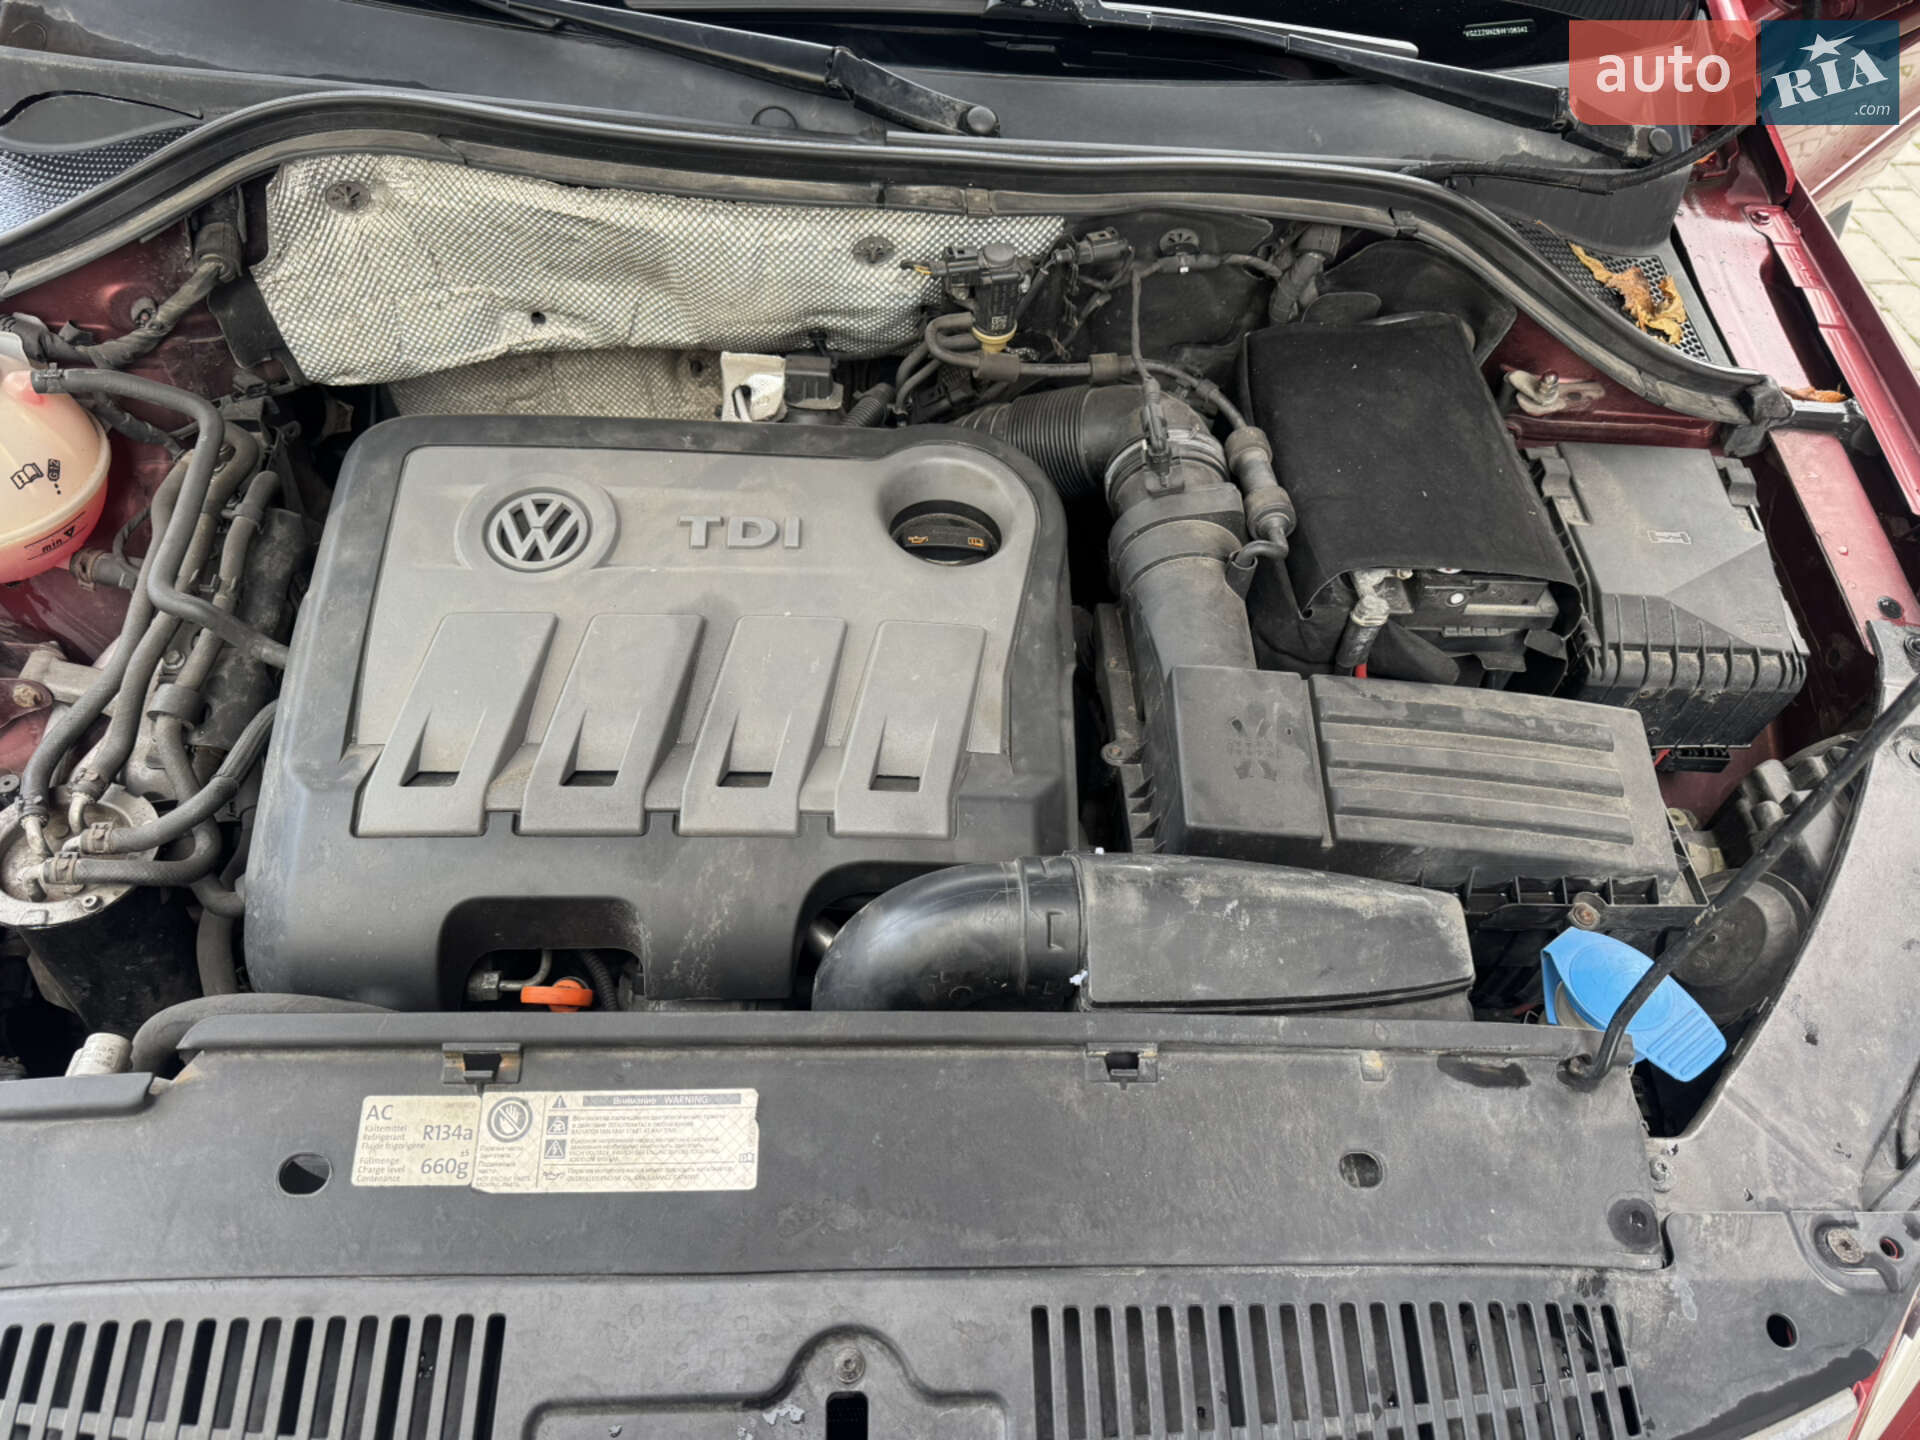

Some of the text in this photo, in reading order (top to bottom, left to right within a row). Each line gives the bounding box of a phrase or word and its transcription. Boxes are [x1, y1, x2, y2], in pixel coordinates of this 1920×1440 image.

[678, 515, 802, 549] TDI
[41, 539, 63, 553] min
[663, 1094, 709, 1105] WARNING
[366, 1104, 394, 1120] AC
[363, 1133, 406, 1142] Refrigerant
[423, 1124, 473, 1141] R134a
[357, 1165, 406, 1175] Charge level
[420, 1158, 469, 1180] 660g
